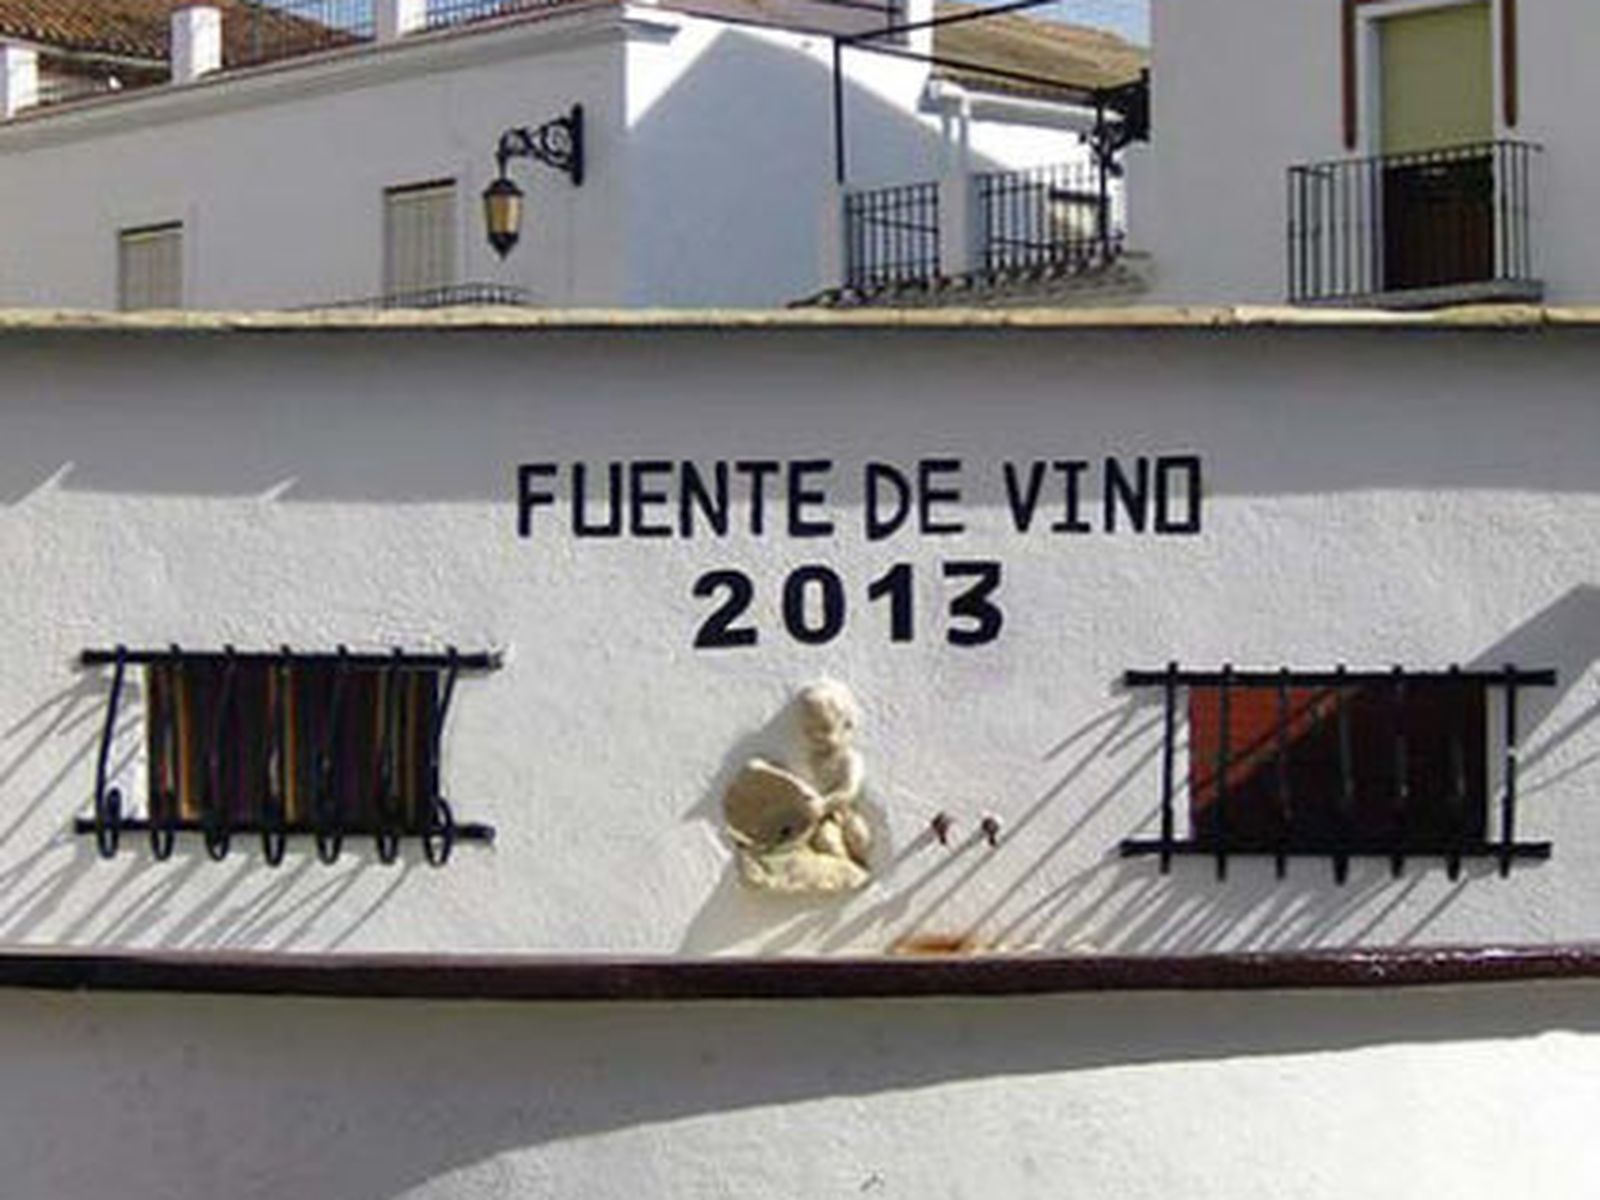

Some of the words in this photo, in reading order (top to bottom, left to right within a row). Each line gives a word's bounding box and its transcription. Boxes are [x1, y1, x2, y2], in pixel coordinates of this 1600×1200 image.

[516, 458, 835, 539] FUENTE
[864, 458, 965, 542] DE
[1002, 455, 1203, 535] VINO
[692, 560, 1005, 649] 2013
